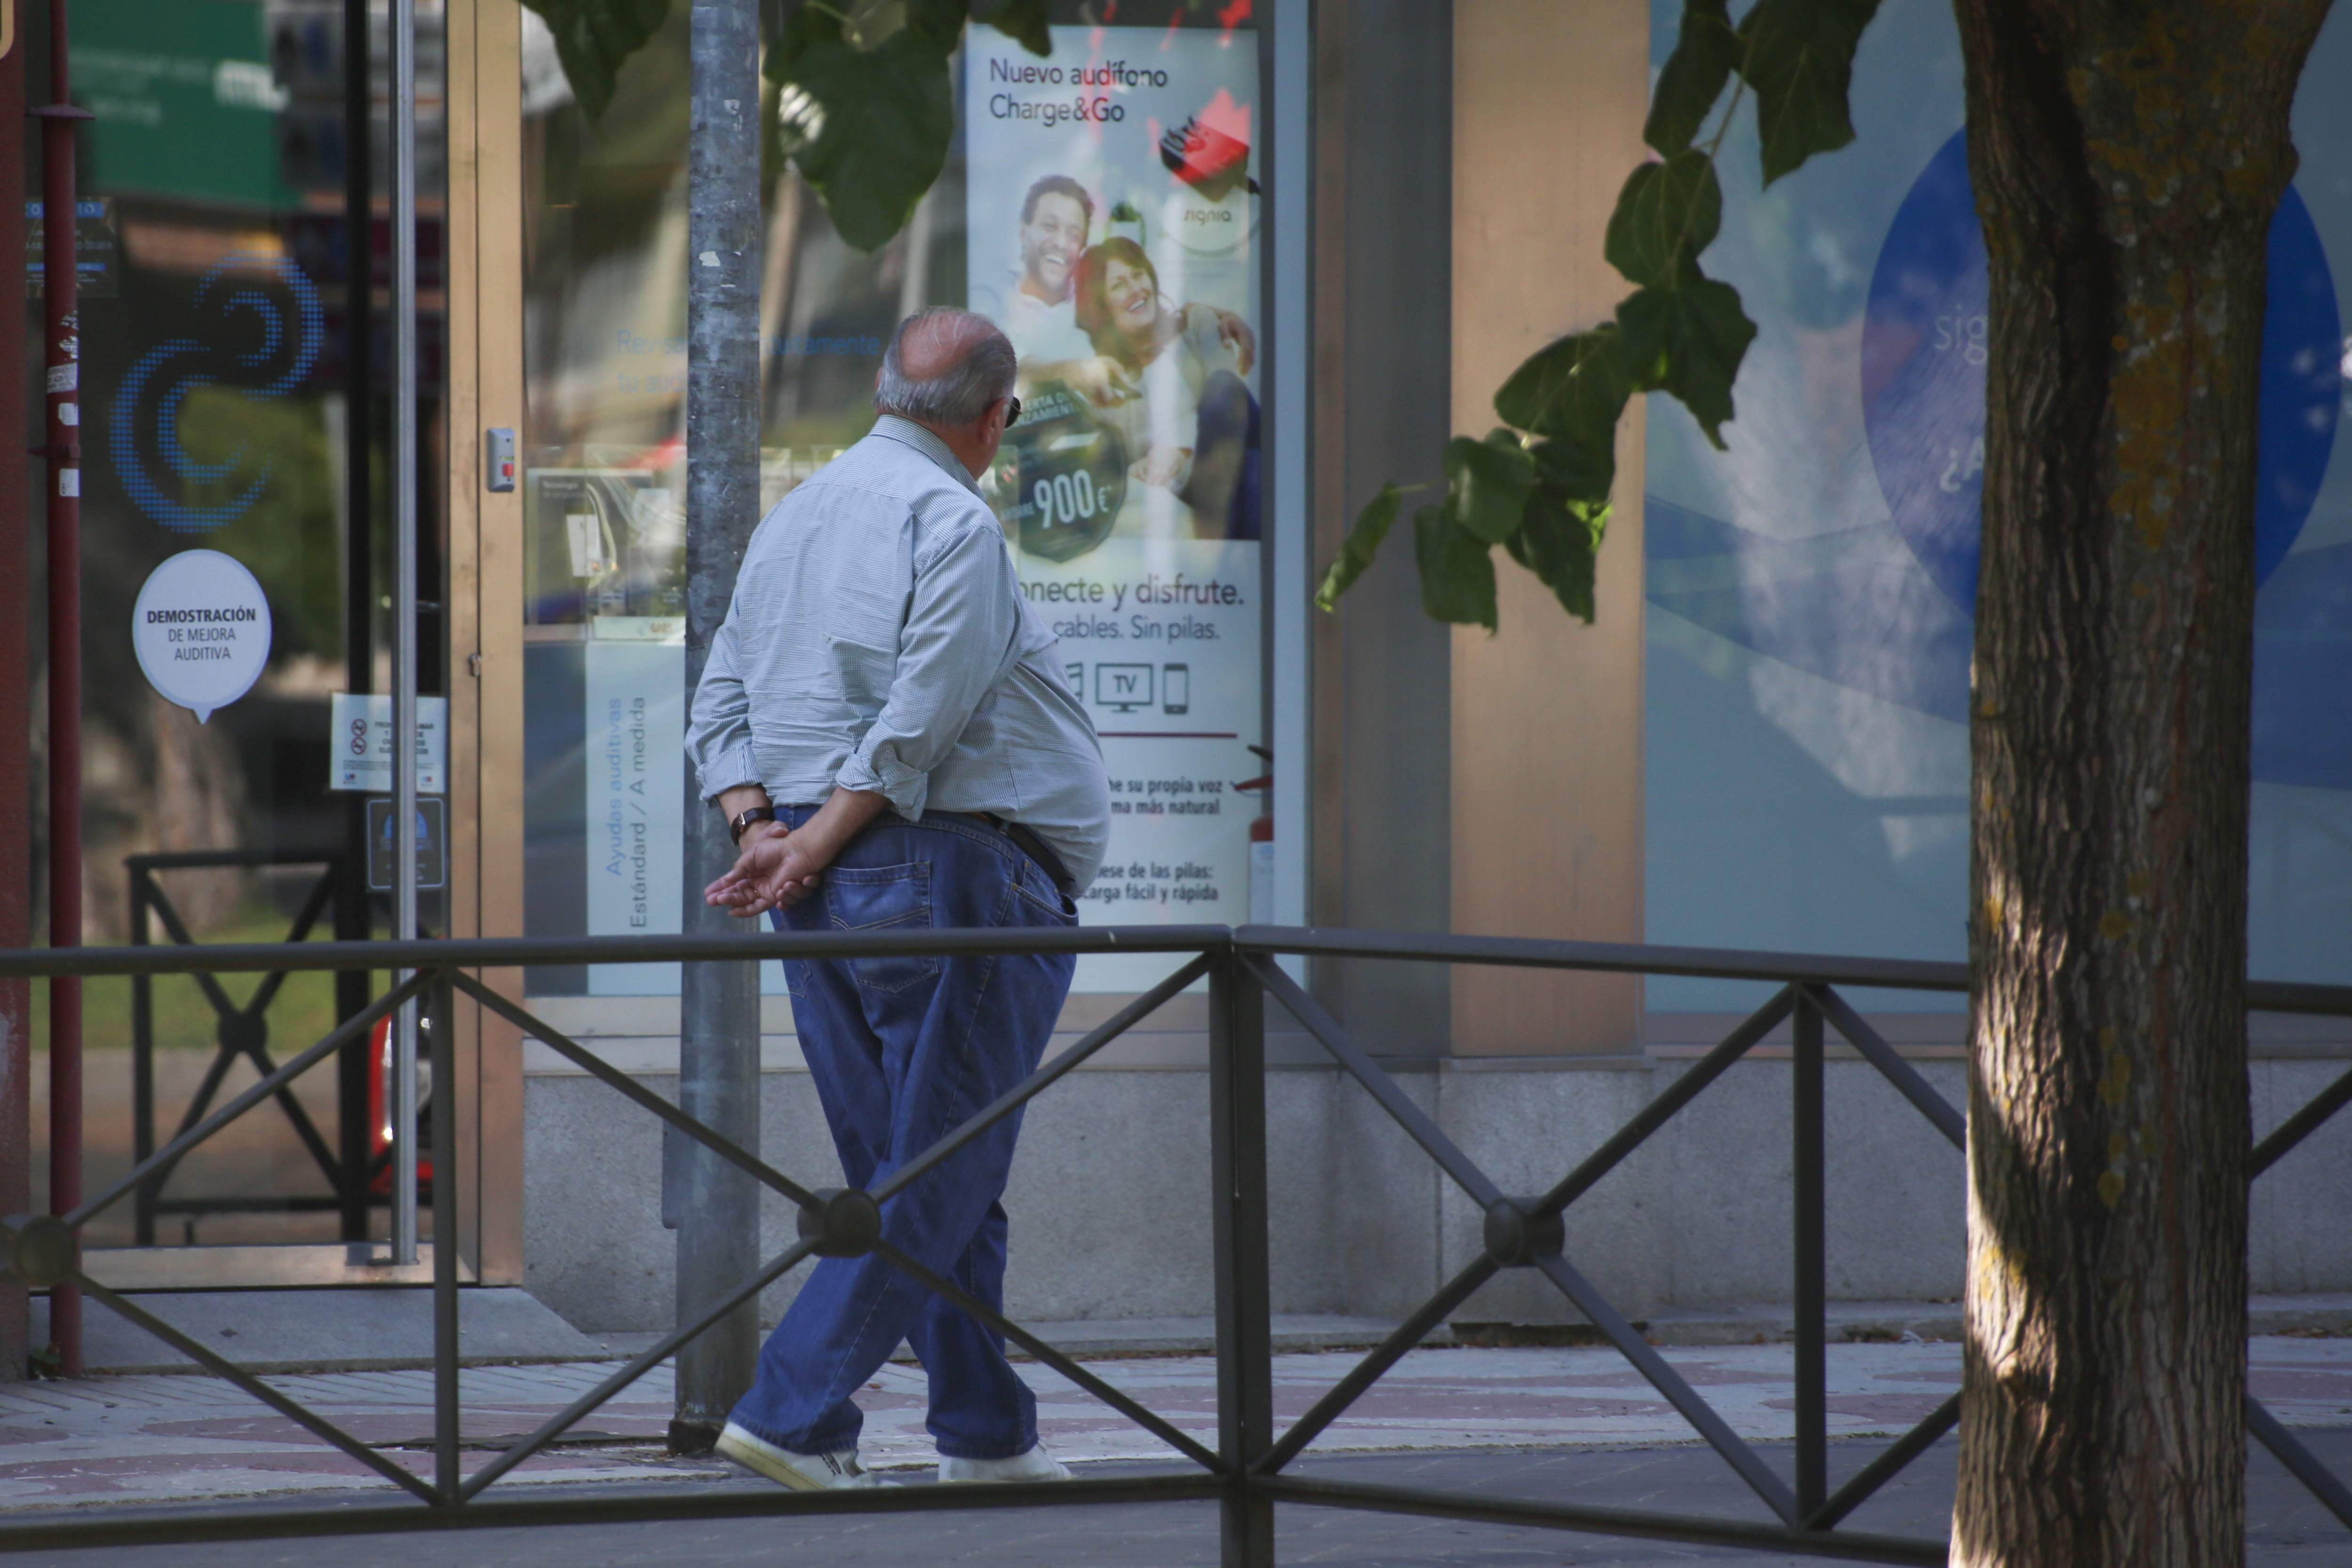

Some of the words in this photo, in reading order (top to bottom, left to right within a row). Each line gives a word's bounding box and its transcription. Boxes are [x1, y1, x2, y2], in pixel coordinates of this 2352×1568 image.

[990, 58, 1063, 83] Nuevo
[1070, 60, 1168, 87] audífono
[989, 93, 1125, 127] Charge&Go
[1112, 583, 1127, 611] y
[1135, 573, 1245, 605] disfrute.
[147, 605, 256, 624] DEMOSTRACIÓN
[168, 629, 184, 642] DE
[188, 627, 237, 641] MEJORA
[1053, 613, 1124, 638] cables.
[1131, 614, 1163, 639] Sin
[1168, 616, 1220, 644] pilas.
[174, 646, 231, 661] AUDITIVA
[1113, 674, 1138, 694] TV
[606, 698, 622, 791] auditivas
[628, 697, 645, 772] medida
[629, 779, 645, 795] A
[1127, 780, 1144, 793] su
[1147, 776, 1194, 797] propia
[1198, 780, 1223, 793] voz
[1136, 798, 1165, 814] más
[1168, 797, 1220, 814] natural
[605, 798, 626, 876] Ayudas
[629, 822, 647, 928] Estándard
[1128, 861, 1146, 879] de
[1150, 860, 1171, 879] las
[1175, 860, 1214, 883] pilas:
[1126, 882, 1156, 900] fácil
[1159, 887, 1168, 904] y
[1173, 883, 1219, 904] rápida
